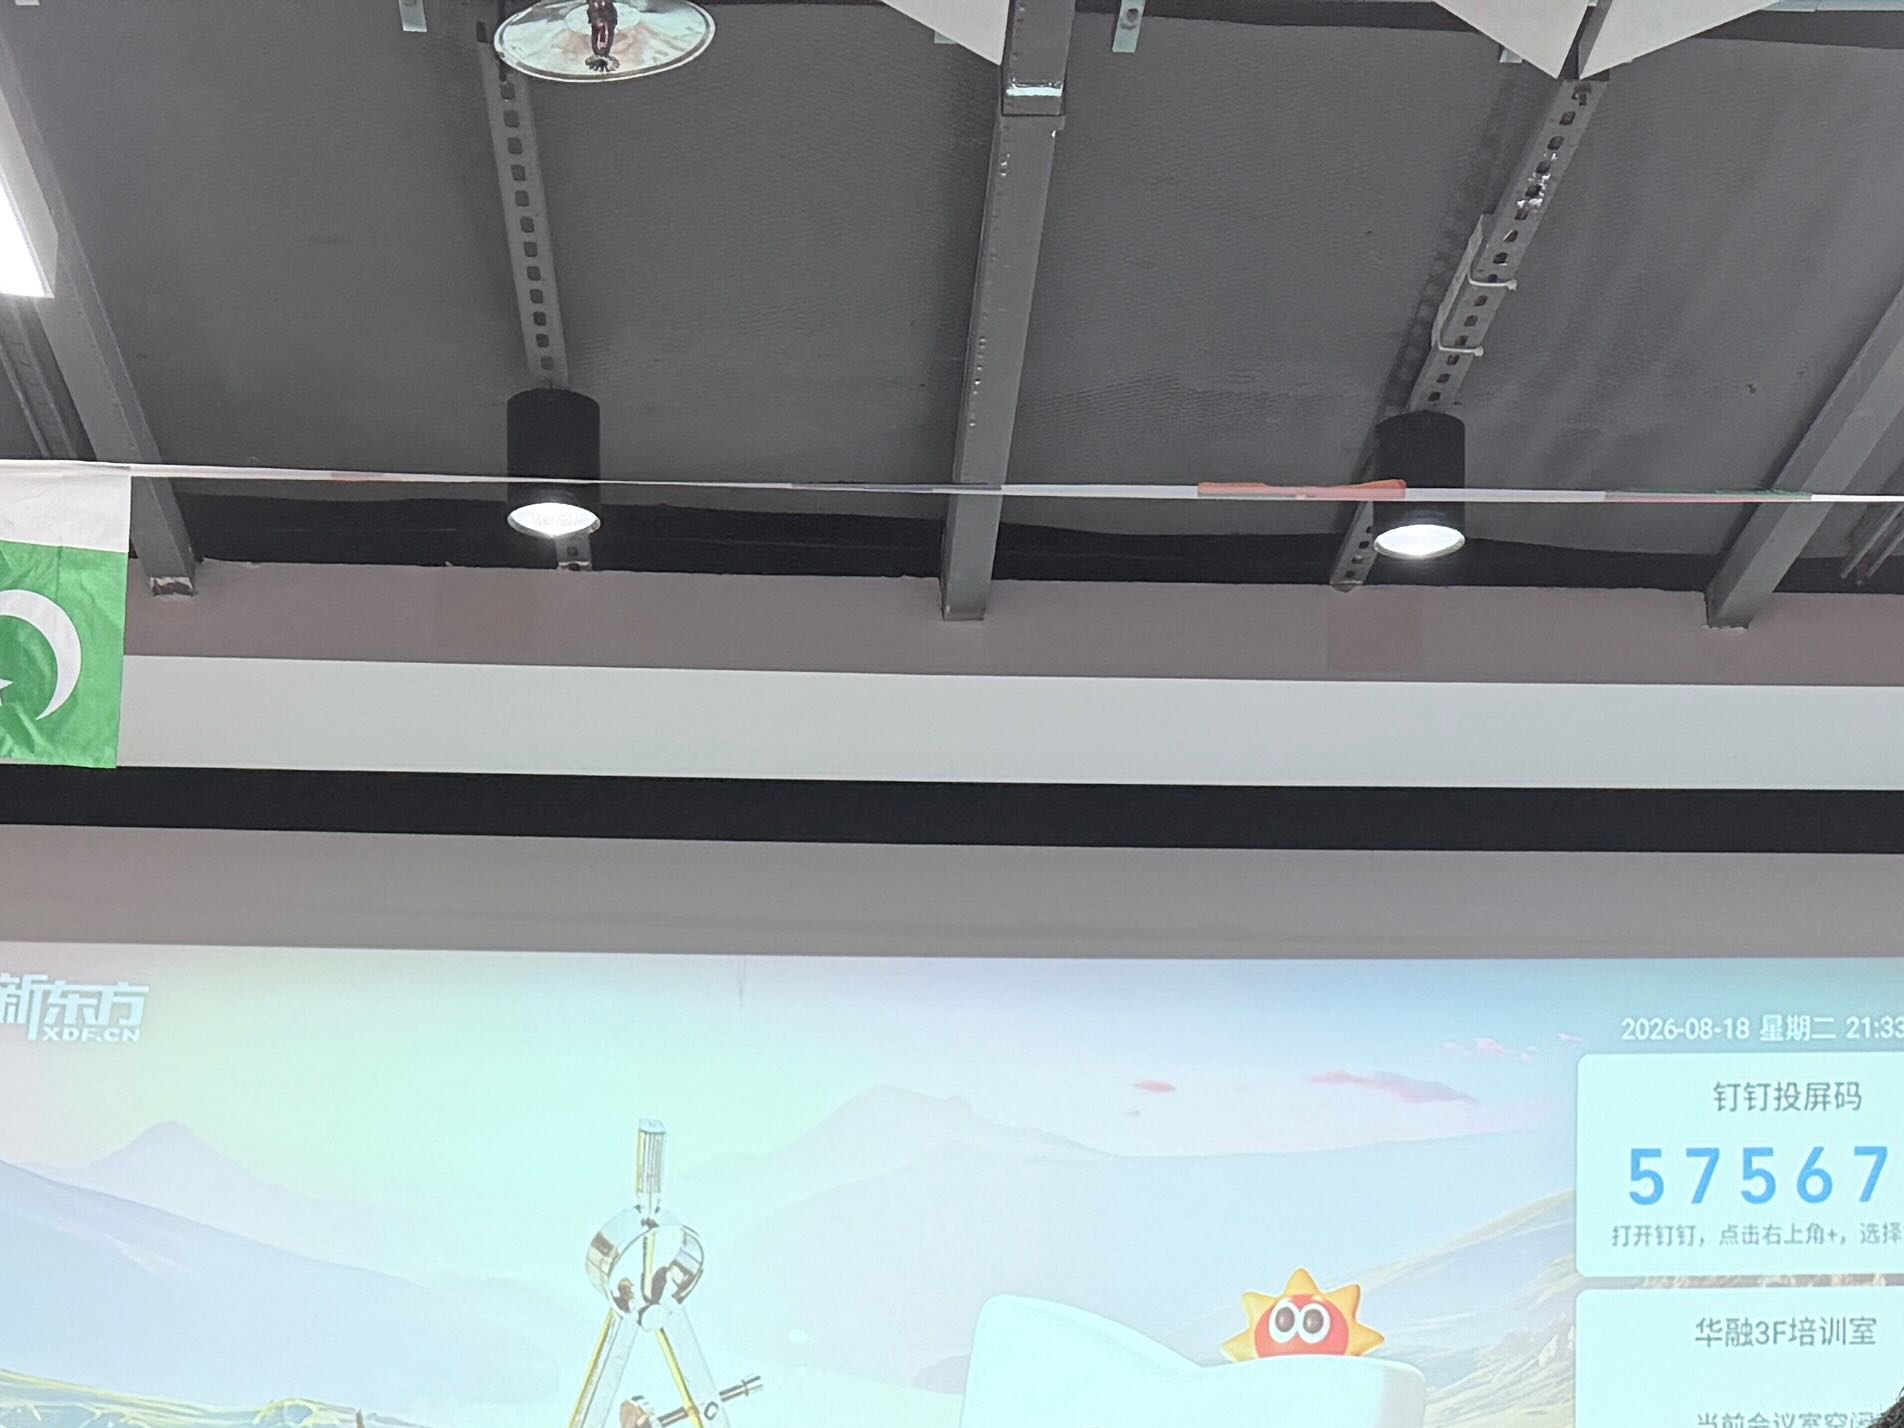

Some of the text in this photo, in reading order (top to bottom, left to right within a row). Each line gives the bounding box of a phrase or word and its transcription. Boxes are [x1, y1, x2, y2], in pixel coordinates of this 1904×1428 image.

[43, 1027, 139, 1041] XDF.CN
[1621, 1018, 1749, 1040] 2026-08-18
[1760, 1015, 1835, 1041] 星期二
[1713, 1081, 1862, 1112] 钉钉投屏码
[1695, 1317, 1877, 1347] 华融3F培训室
